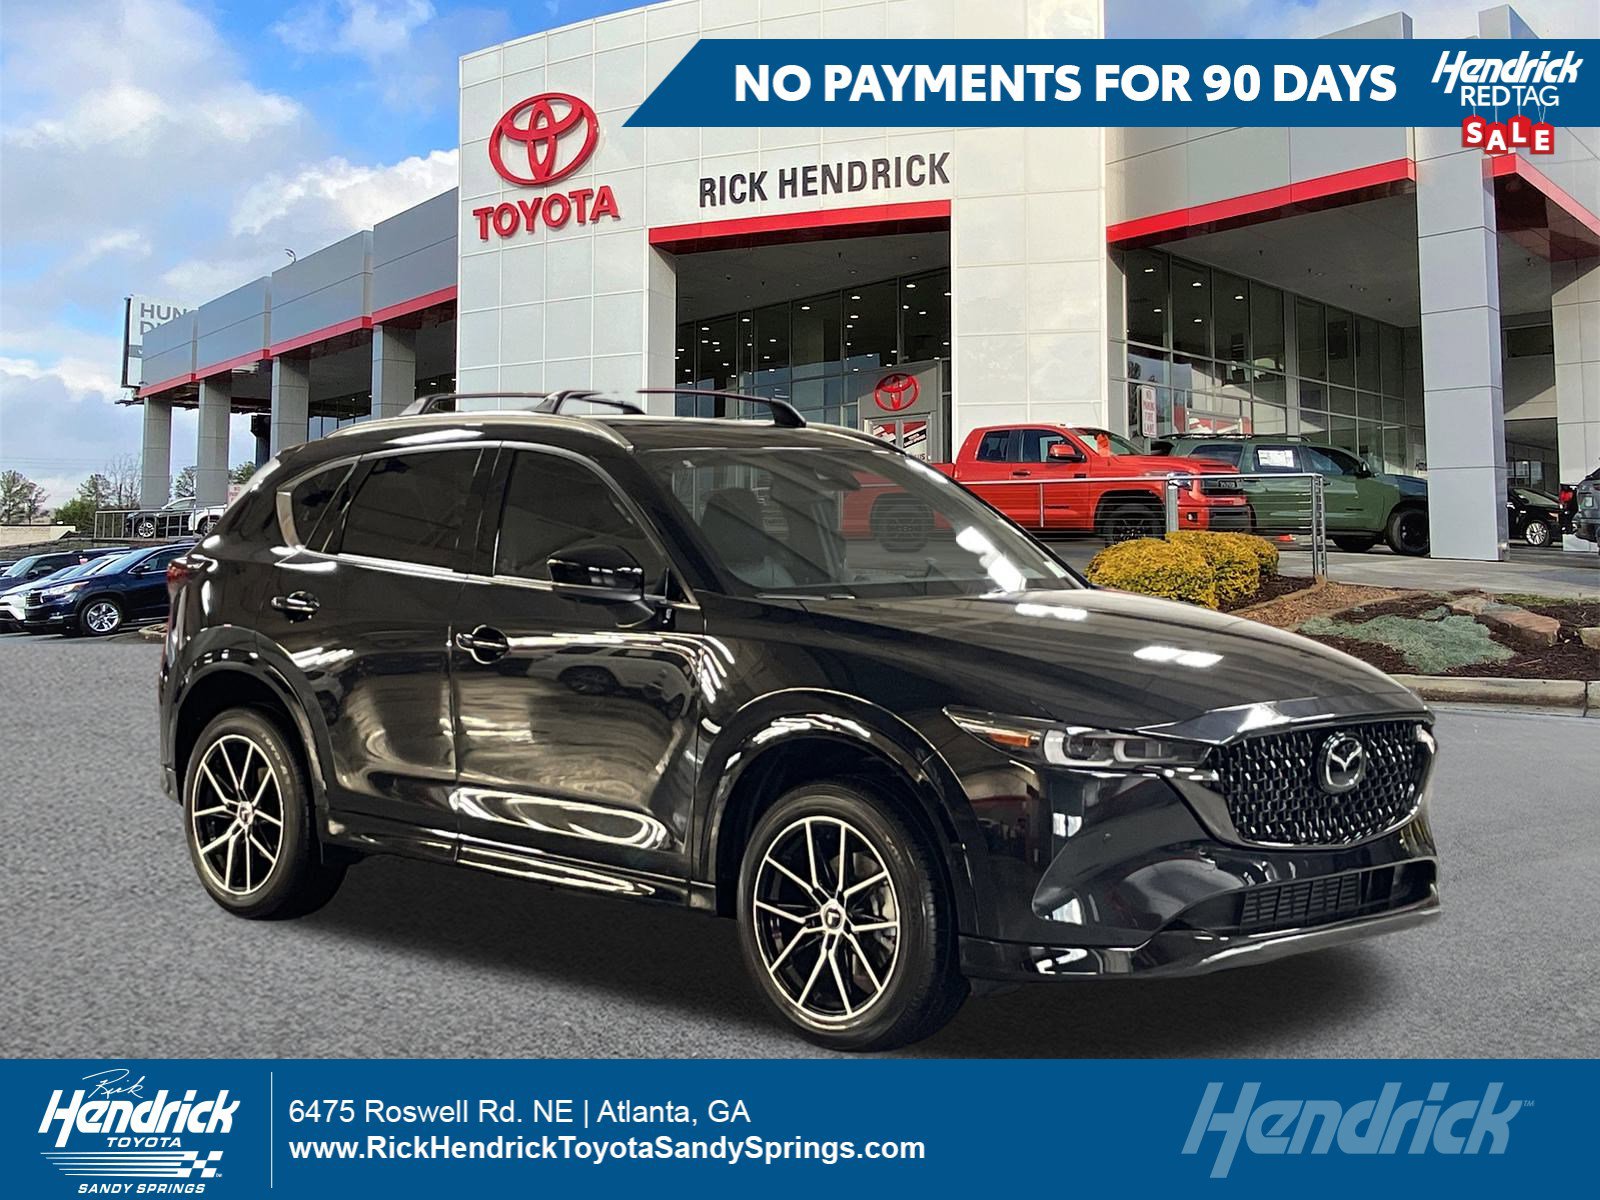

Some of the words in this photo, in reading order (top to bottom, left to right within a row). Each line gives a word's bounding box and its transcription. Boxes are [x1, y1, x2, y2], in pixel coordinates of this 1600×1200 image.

[699, 170, 768, 208] RICK
[779, 152, 951, 200] HENDRICK
[472, 185, 620, 241] TOYOTA
